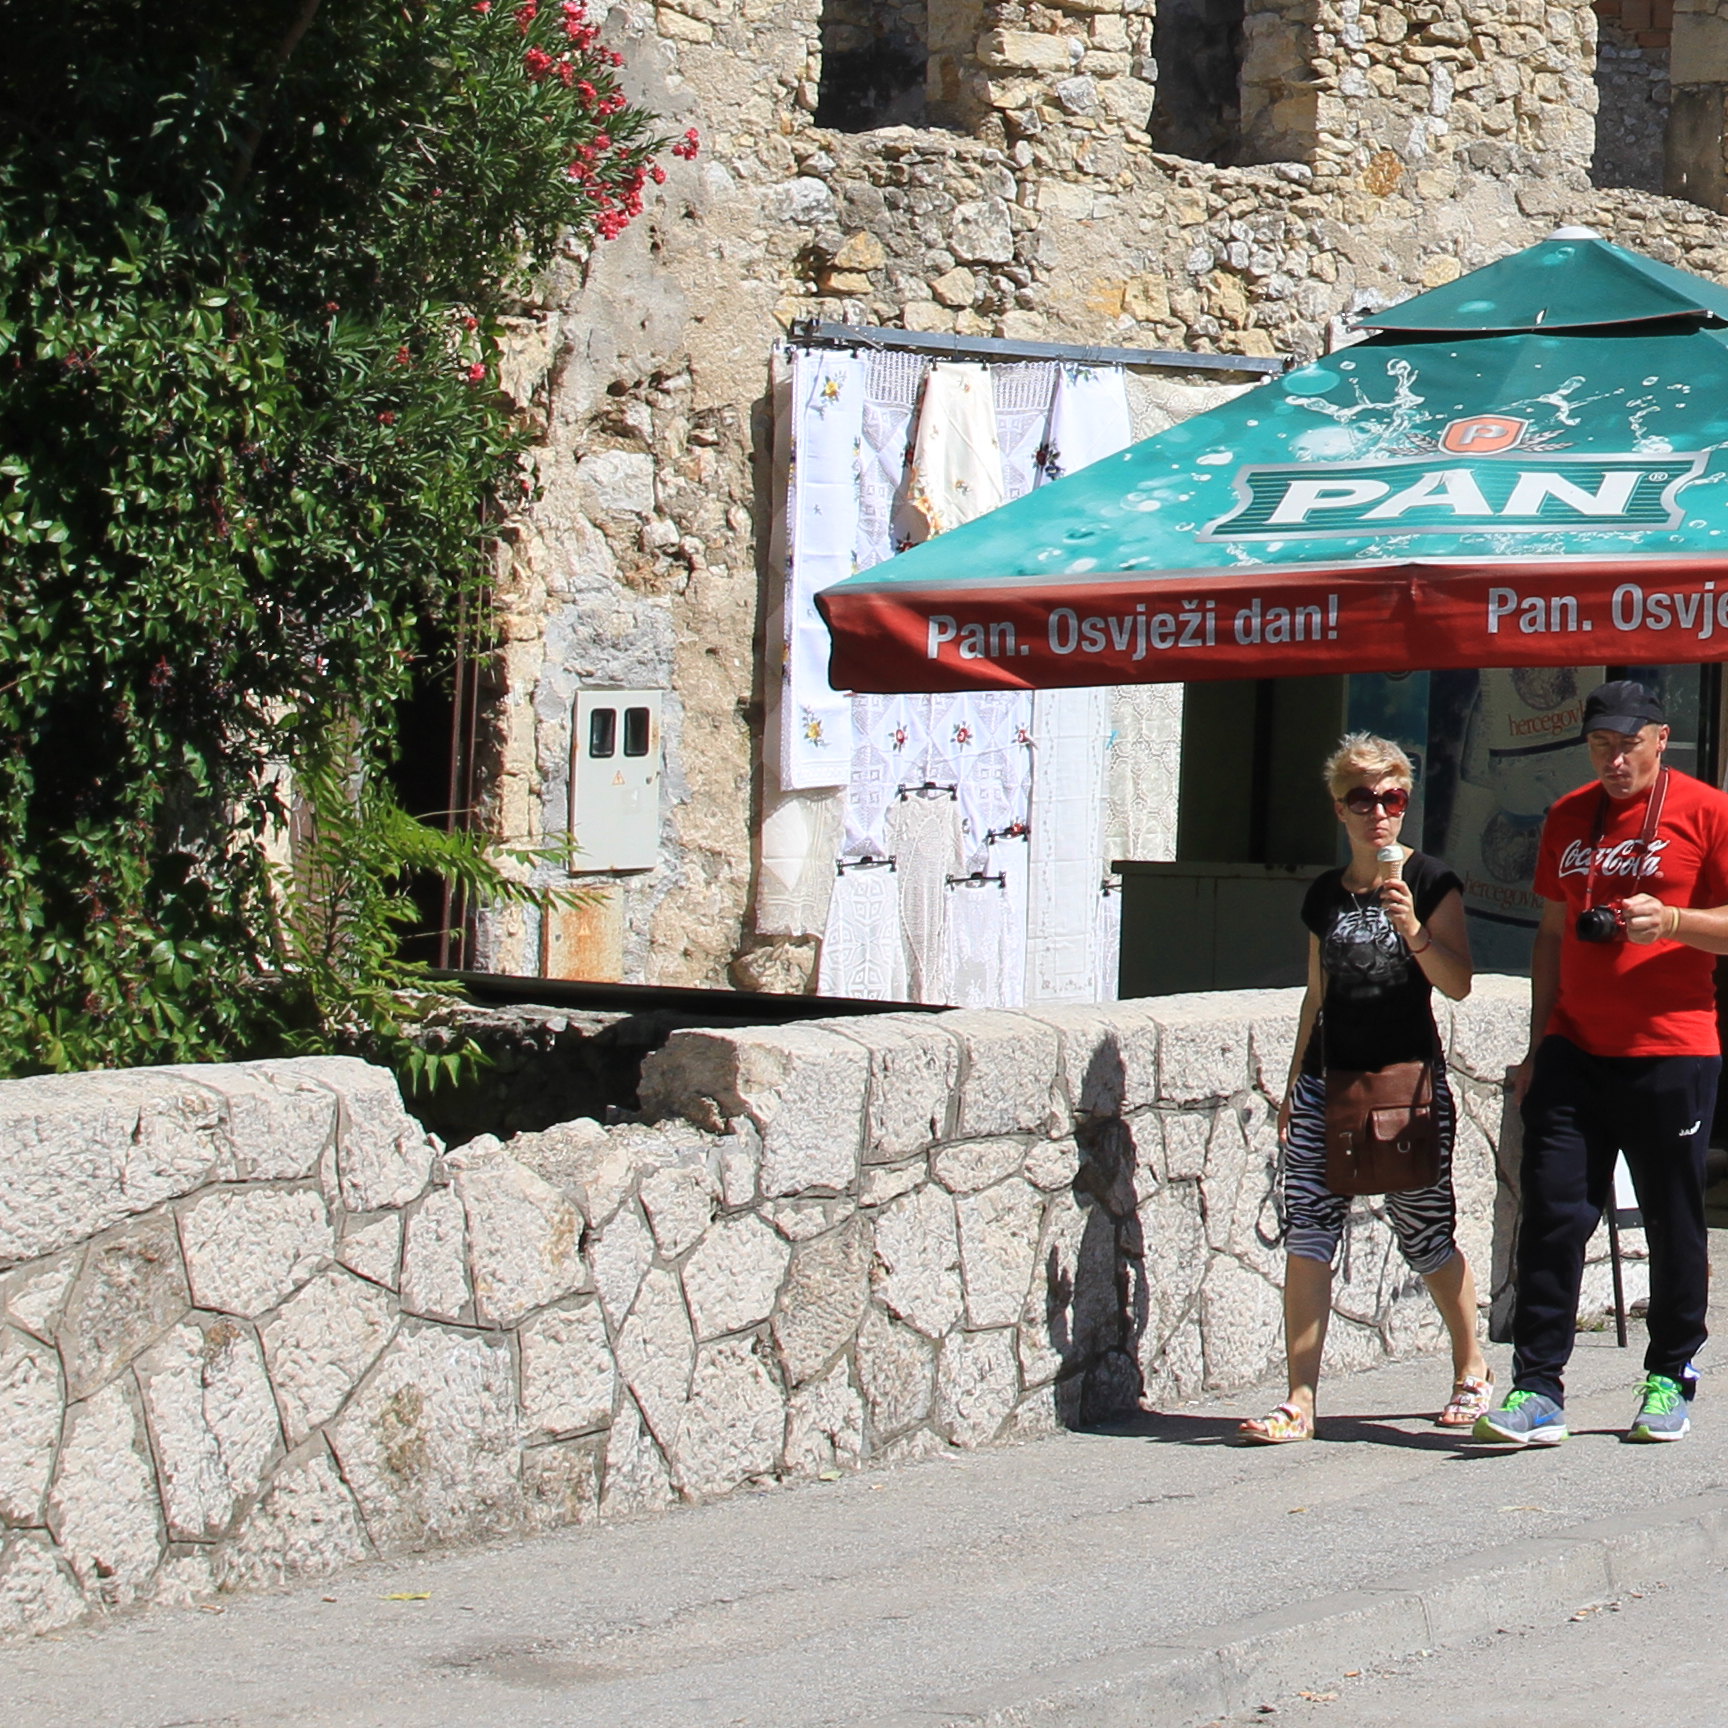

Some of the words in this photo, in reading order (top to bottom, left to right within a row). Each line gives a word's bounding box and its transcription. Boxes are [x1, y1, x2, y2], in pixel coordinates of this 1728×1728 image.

[1264, 469, 1648, 525] PAN
[927, 615, 1030, 660] Pan.
[1048, 599, 1217, 661] Osvježi
[1234, 594, 1340, 646] dan!
[1487, 587, 1593, 634] Pan.
[1508, 700, 1586, 737] hercegov
